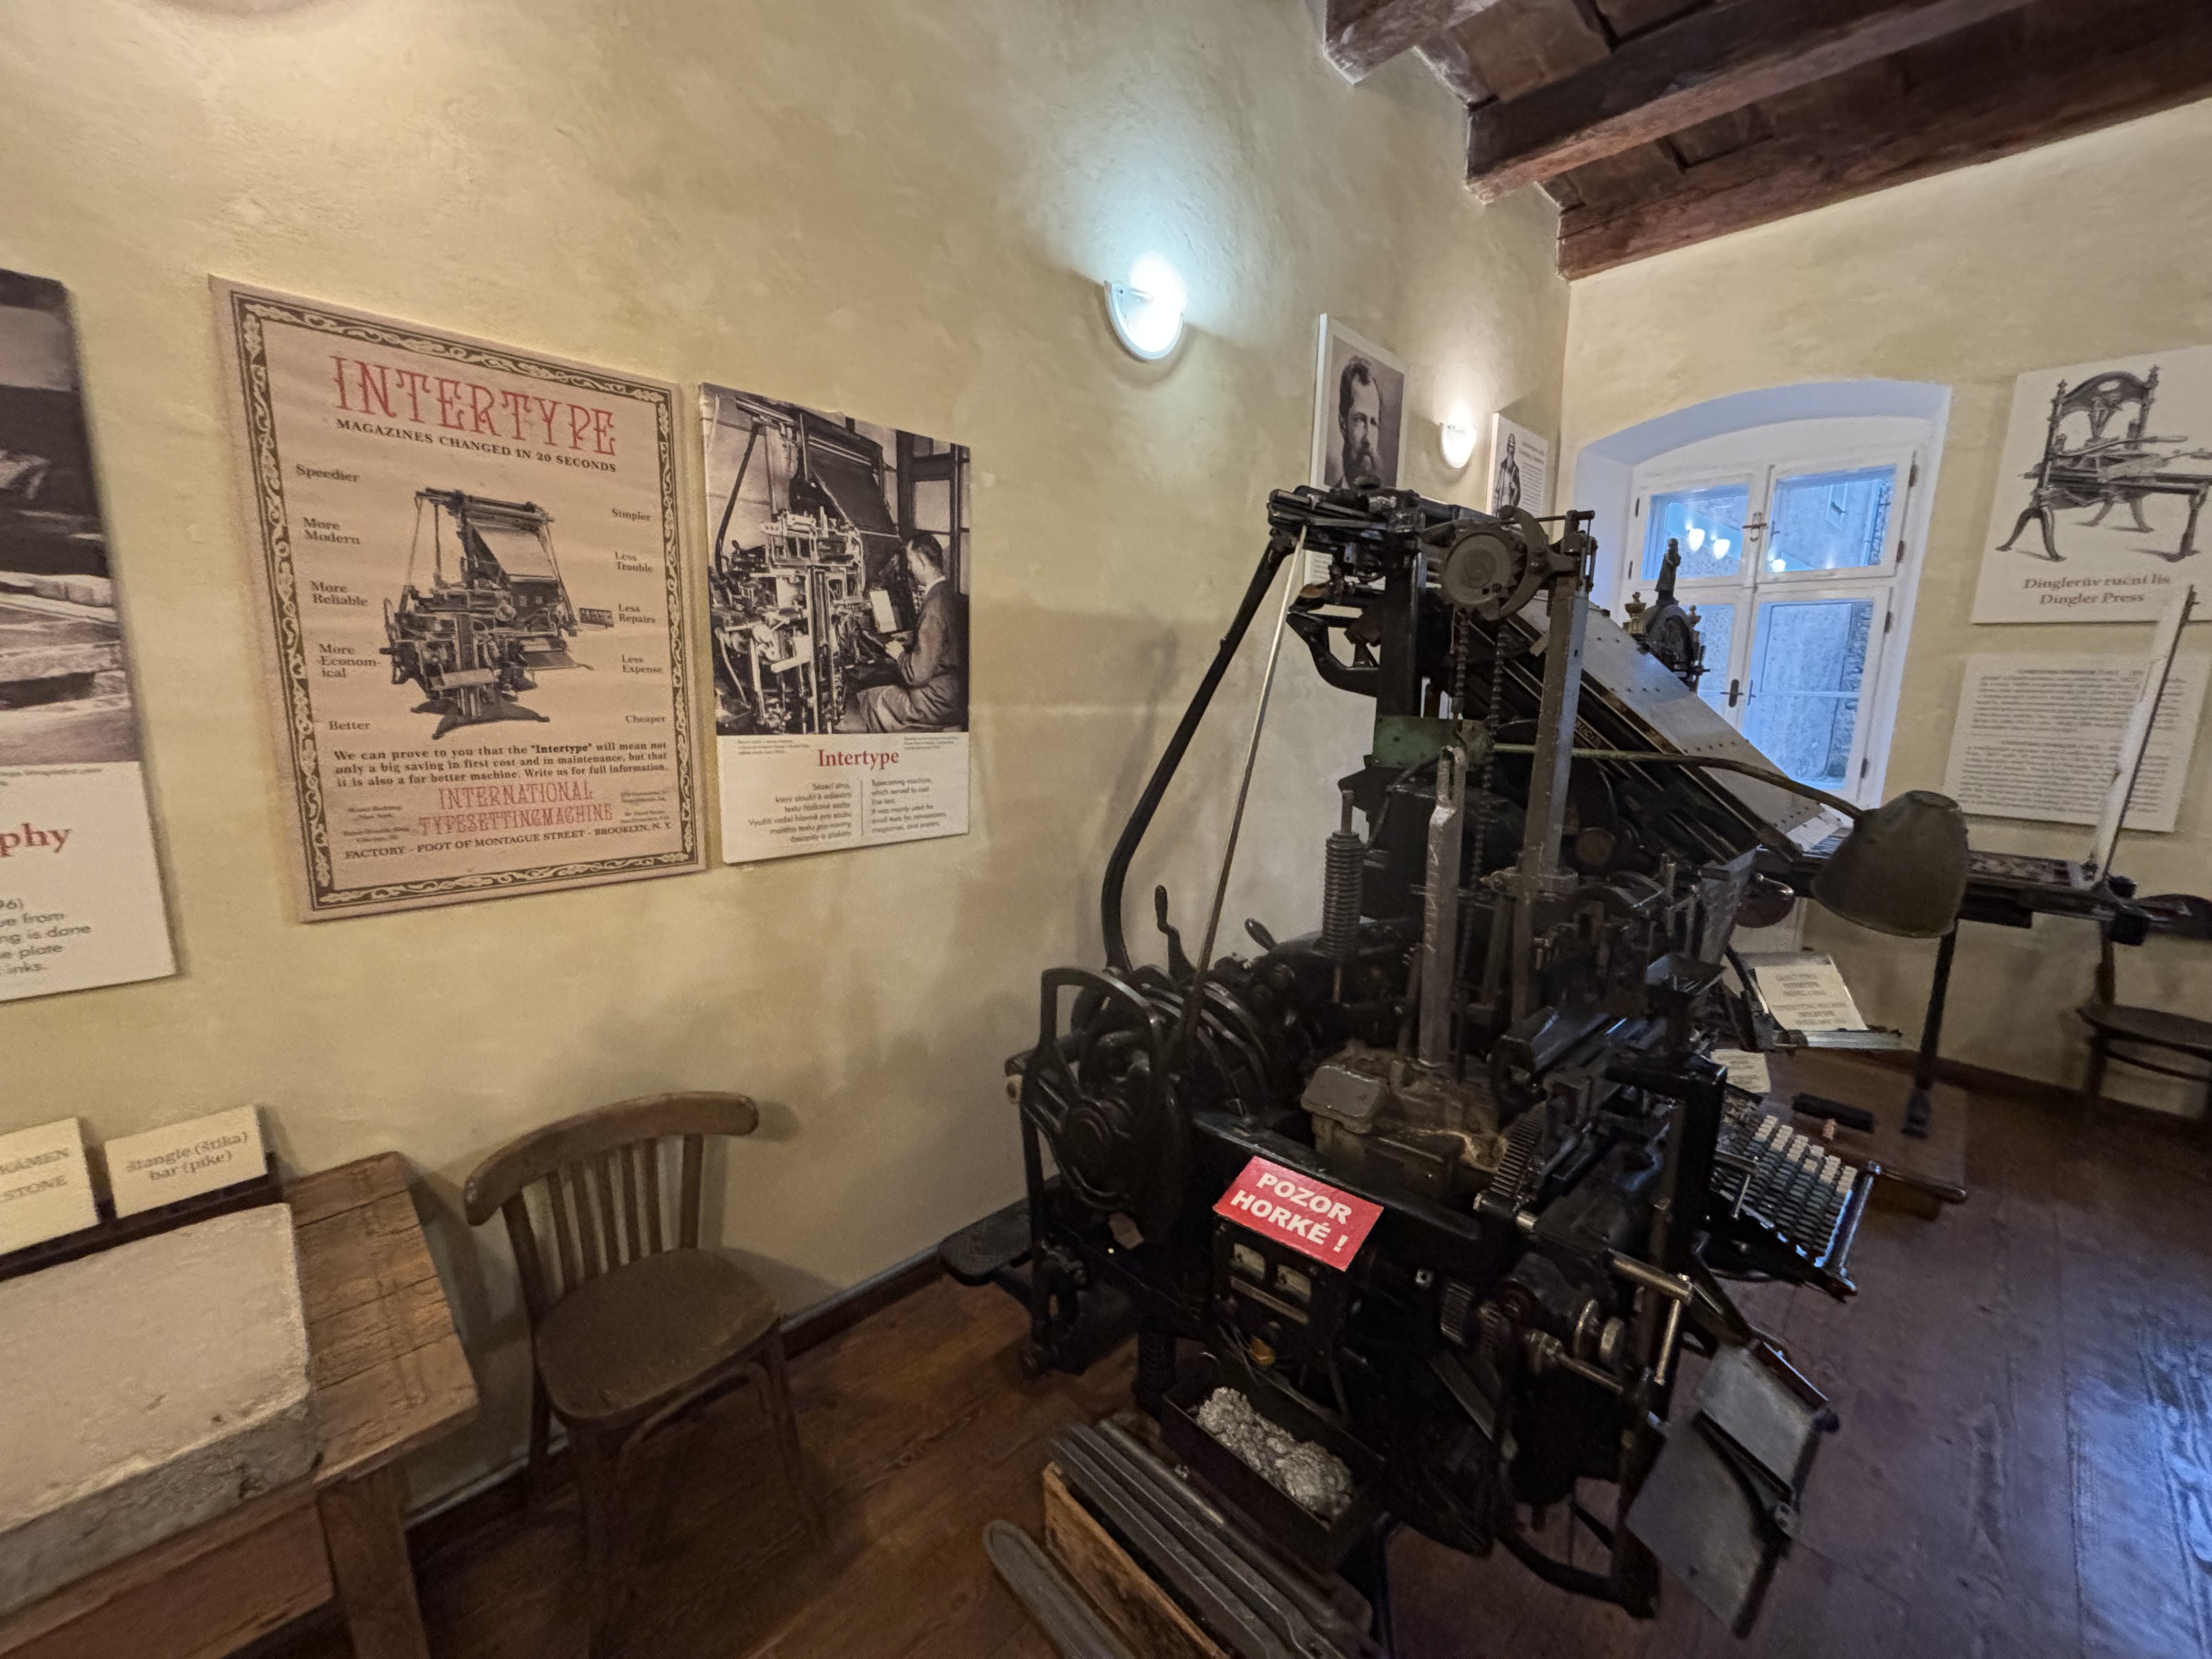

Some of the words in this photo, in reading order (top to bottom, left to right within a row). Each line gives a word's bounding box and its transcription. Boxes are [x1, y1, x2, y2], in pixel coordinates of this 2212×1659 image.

[329, 356, 616, 456] INTERTYPE
[336, 419, 433, 443] MAGAZINES
[439, 436, 510, 456] CHANGED
[516, 448, 531, 459] IN
[537, 453, 551, 462] 20
[556, 455, 616, 472] SECONDS
[296, 464, 360, 482] Speedier
[612, 508, 651, 521] Simpler
[303, 517, 340, 531] More
[304, 529, 360, 544] Modern
[614, 551, 637, 561] Less
[617, 561, 653, 573] Trouble
[2151, 573, 2170, 584] lis
[311, 580, 348, 593] More
[313, 594, 368, 606] Reliable
[2040, 593, 2099, 607] Dingler
[2102, 592, 2145, 603] Press
[619, 603, 641, 613] Less
[619, 613, 656, 624] Repairs
[319, 644, 356, 654] More
[320, 656, 381, 667] Econom-
[622, 654, 644, 663] Less
[322, 668, 347, 678] ical
[623, 665, 663, 675] Expense
[329, 721, 370, 730] Better
[626, 715, 665, 724] Cheaper
[335, 751, 355, 760] We
[361, 752, 386, 760] can
[392, 751, 428, 761] prove
[434, 748, 447, 757] to
[452, 749, 473, 758] you
[478, 746, 504, 756] that
[509, 744, 528, 754] the
[596, 742, 615, 751] will
[336, 764, 363, 775] only
[380, 763, 401, 774] big
[405, 761, 444, 771] saving
[448, 760, 460, 769] in
[464, 759, 489, 768] first
[493, 759, 516, 767] cost
[521, 755, 540, 766] and
[544, 756, 554, 764] in
[629, 753, 644, 761] but
[819, 749, 899, 770] Intertype
[337, 777, 346, 787] it
[352, 776, 363, 786] is
[368, 775, 393, 786] also
[409, 774, 427, 784] far
[431, 772, 466, 782] better
[470, 769, 521, 780] machine.
[524, 768, 553, 778] Write
[572, 765, 586, 775] for
[589, 765, 606, 775] full
[610, 763, 668, 773] information.
[439, 781, 593, 809] INTERNATIONAL
[345, 846, 405, 859] FACTORY
[417, 842, 452, 852] FOOT
[455, 840, 472, 850] OF
[475, 834, 541, 847] MONTAGUE
[543, 830, 586, 840] STREET
[22, 913, 65, 923] from
[28, 929, 41, 939] is
[46, 926, 91, 938] done
[19, 945, 63, 960] plate
[149, 1167, 178, 1180] bar
[183, 1150, 232, 1173] (pike)
[1256, 1172, 1352, 1224] POZOR
[1230, 1190, 1331, 1245] HORKÉ
